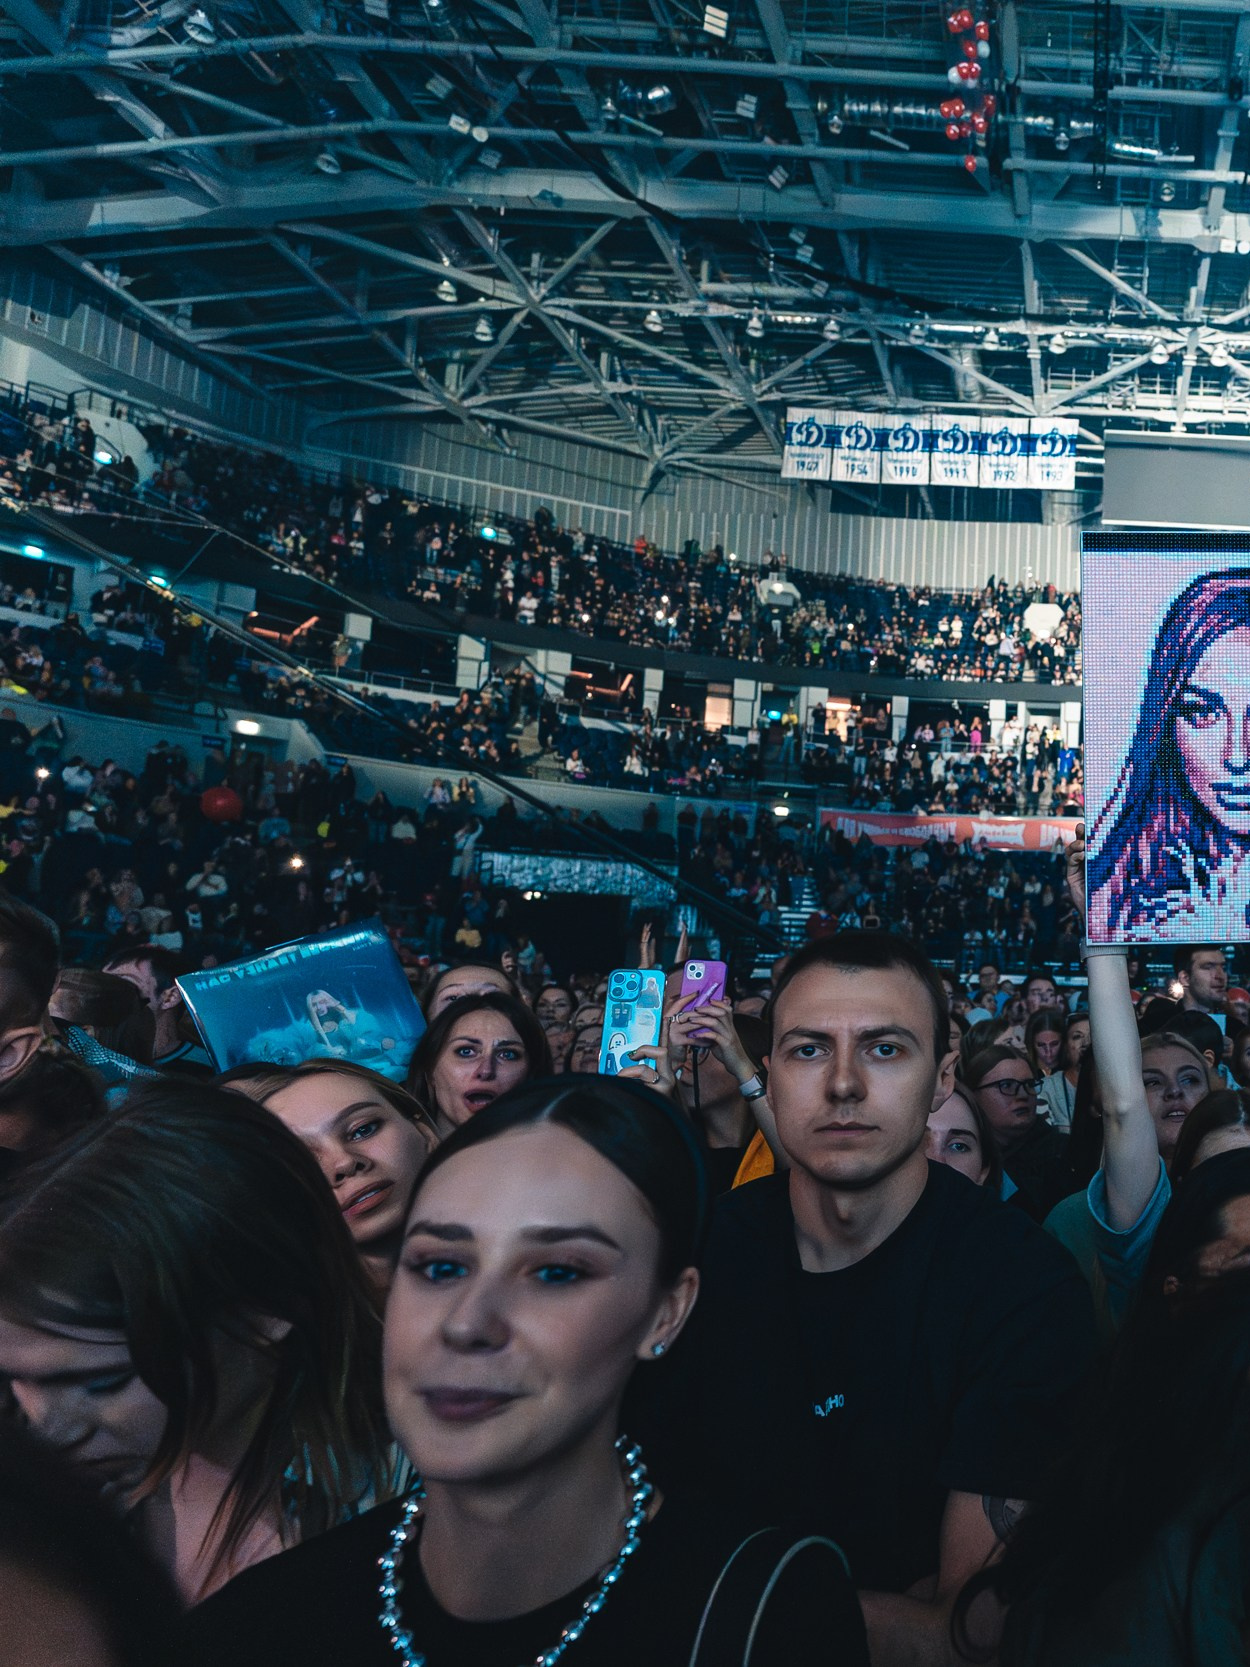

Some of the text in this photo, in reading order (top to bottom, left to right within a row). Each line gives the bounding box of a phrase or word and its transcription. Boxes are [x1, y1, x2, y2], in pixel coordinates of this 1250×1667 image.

[846, 463, 868, 478] 1954
[993, 470, 1015, 481] 1992
[194, 974, 231, 991] НАС
